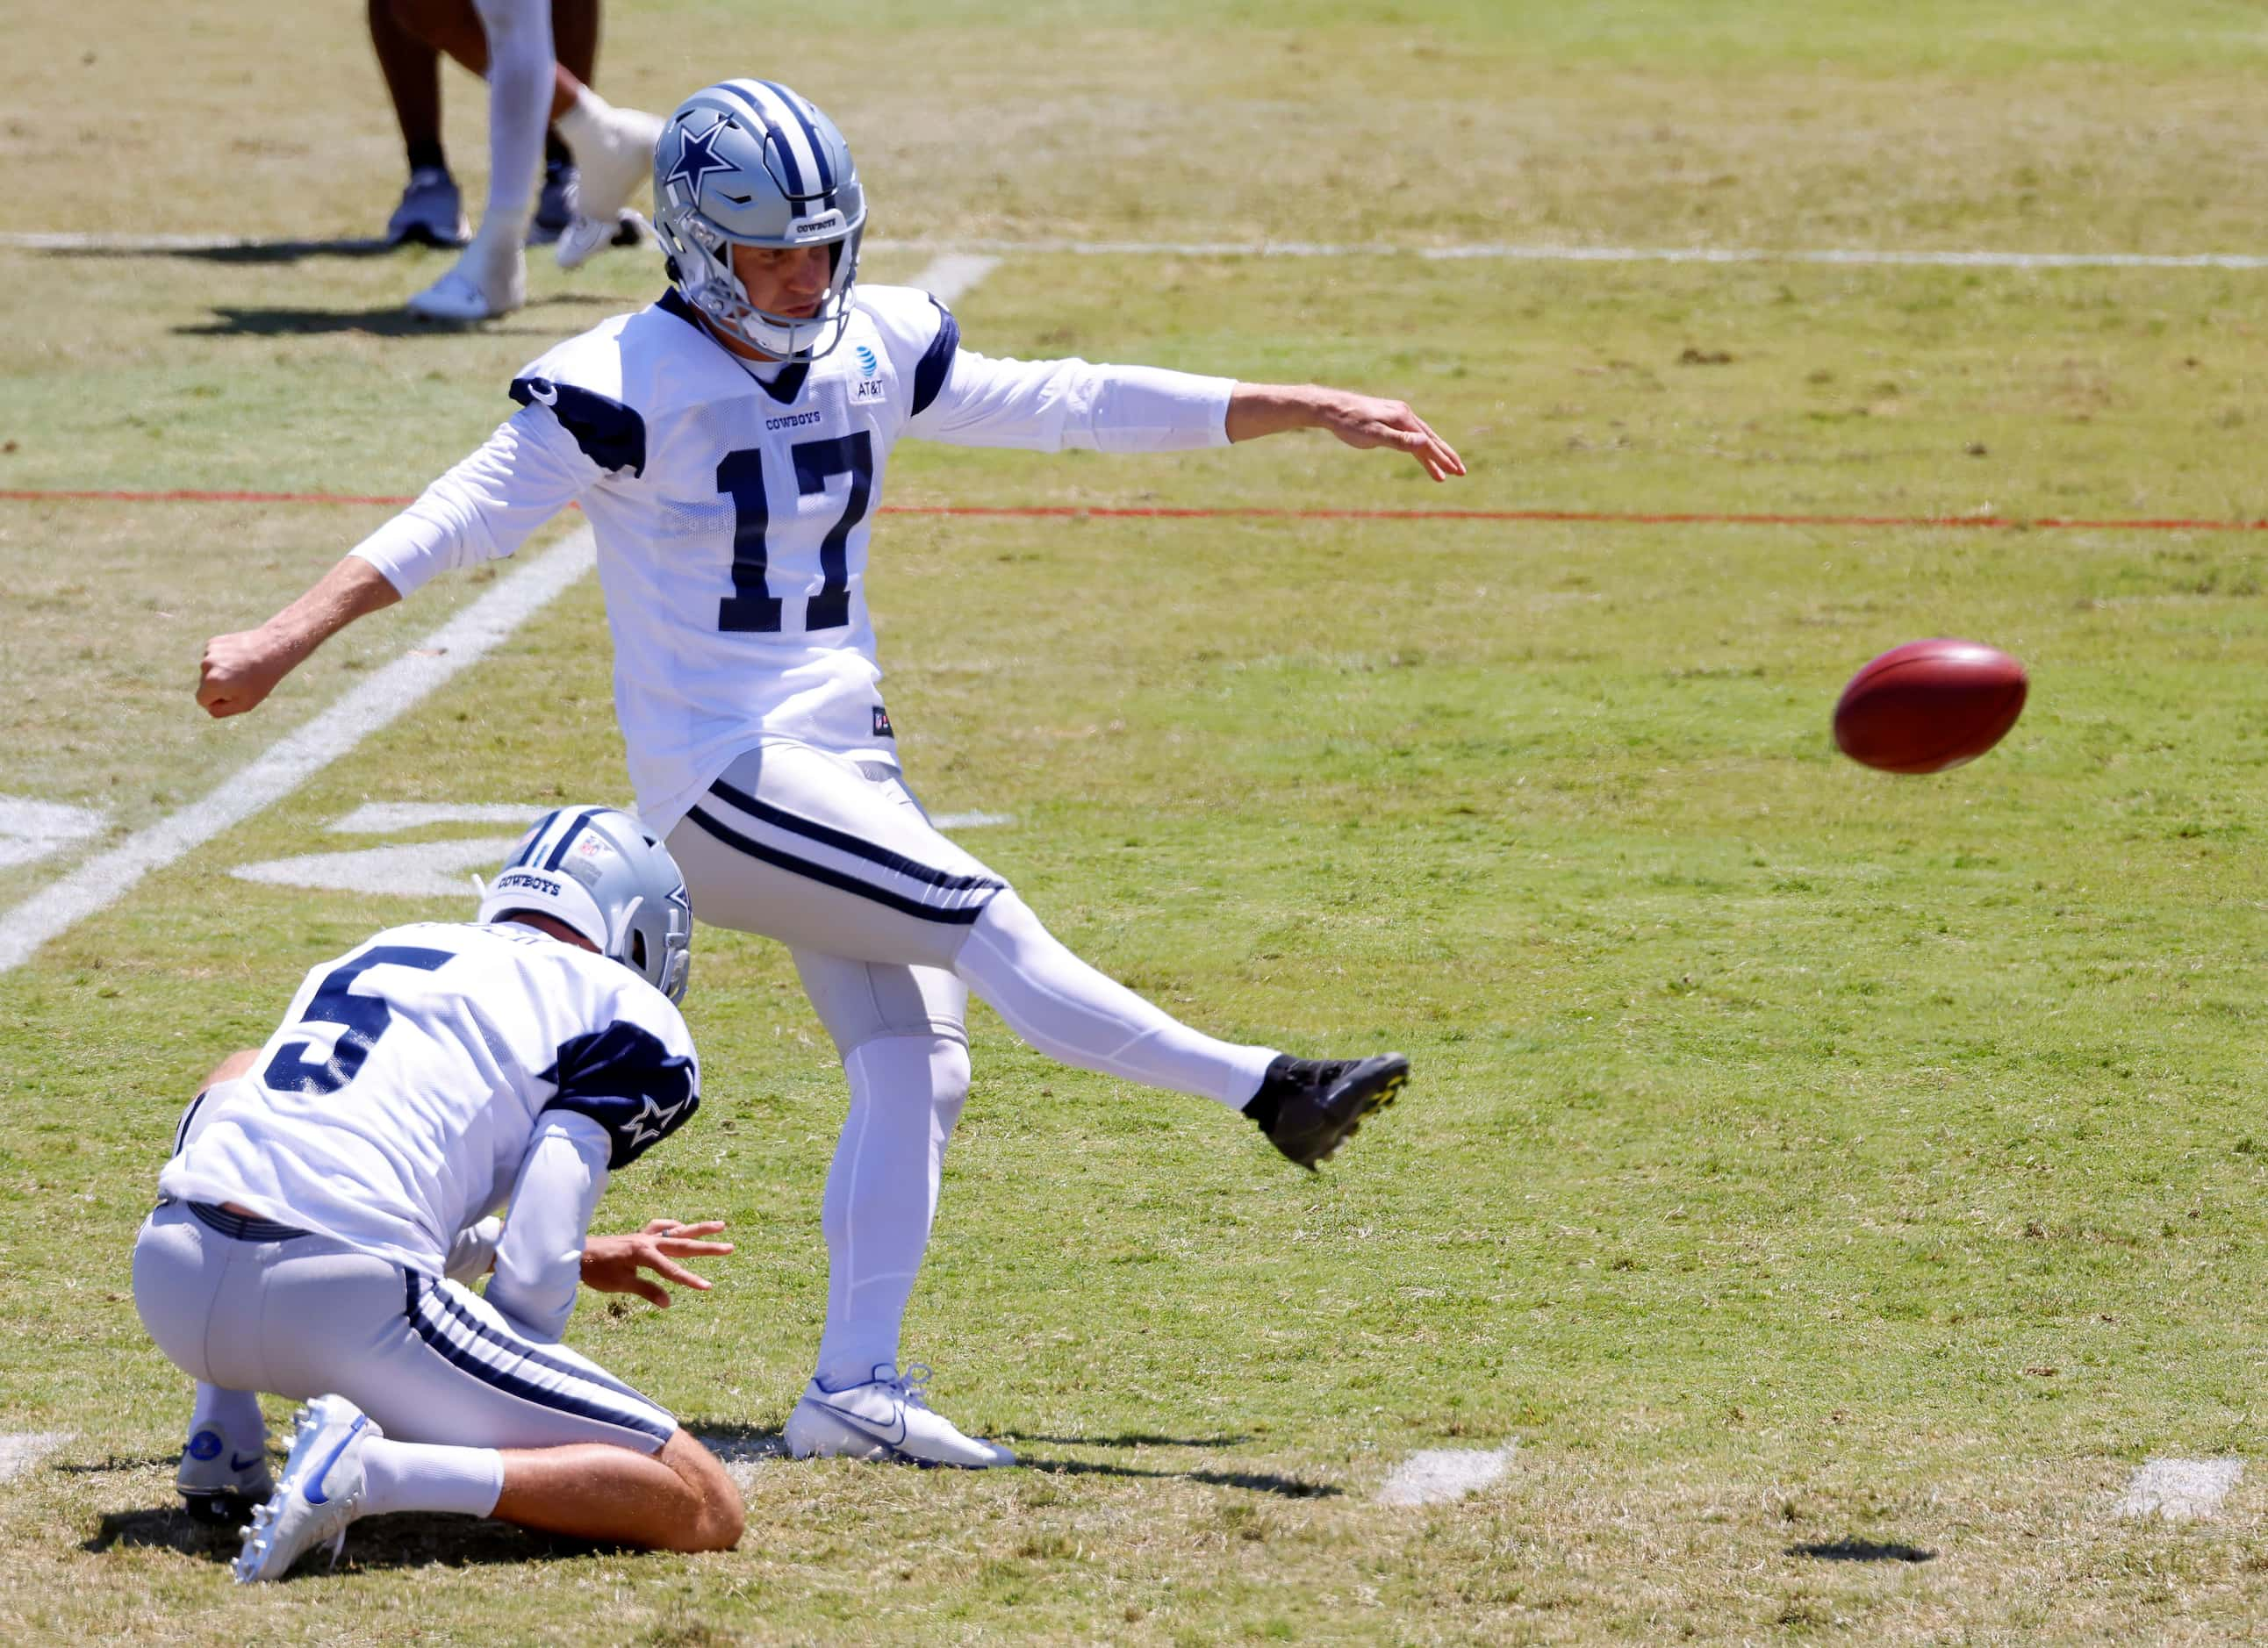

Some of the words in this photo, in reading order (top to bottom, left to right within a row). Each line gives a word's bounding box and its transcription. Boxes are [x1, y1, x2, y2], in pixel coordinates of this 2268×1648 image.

[858, 380, 883, 399] AT&T
[765, 412, 821, 430] COWBOYS
[716, 430, 874, 632] 17
[498, 874, 562, 897] COWBOYS
[262, 945, 459, 1096] 5
